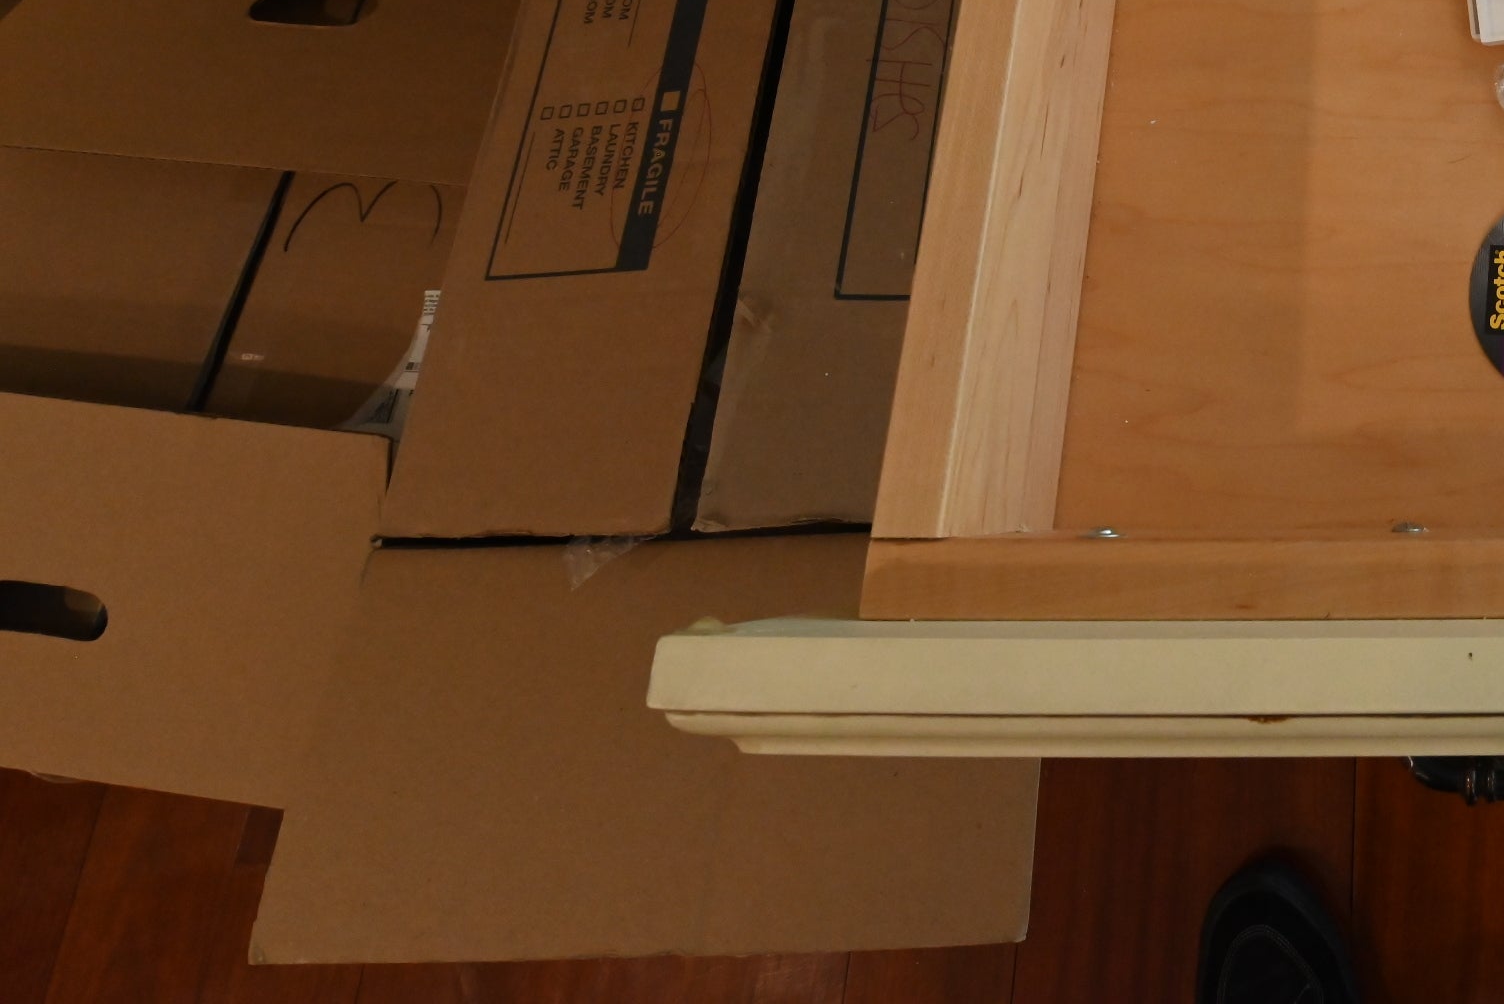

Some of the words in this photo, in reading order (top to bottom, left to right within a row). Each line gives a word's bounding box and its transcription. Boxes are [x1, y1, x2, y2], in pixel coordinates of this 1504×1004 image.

[546, 128, 565, 172] ATTIC
[558, 127, 584, 192] GARAGE
[572, 125, 603, 211] BASEMENT
[596, 123, 622, 197] LAUNDRY
[613, 121, 639, 189] KITCHEN
[637, 118, 673, 216] FRAGILE
